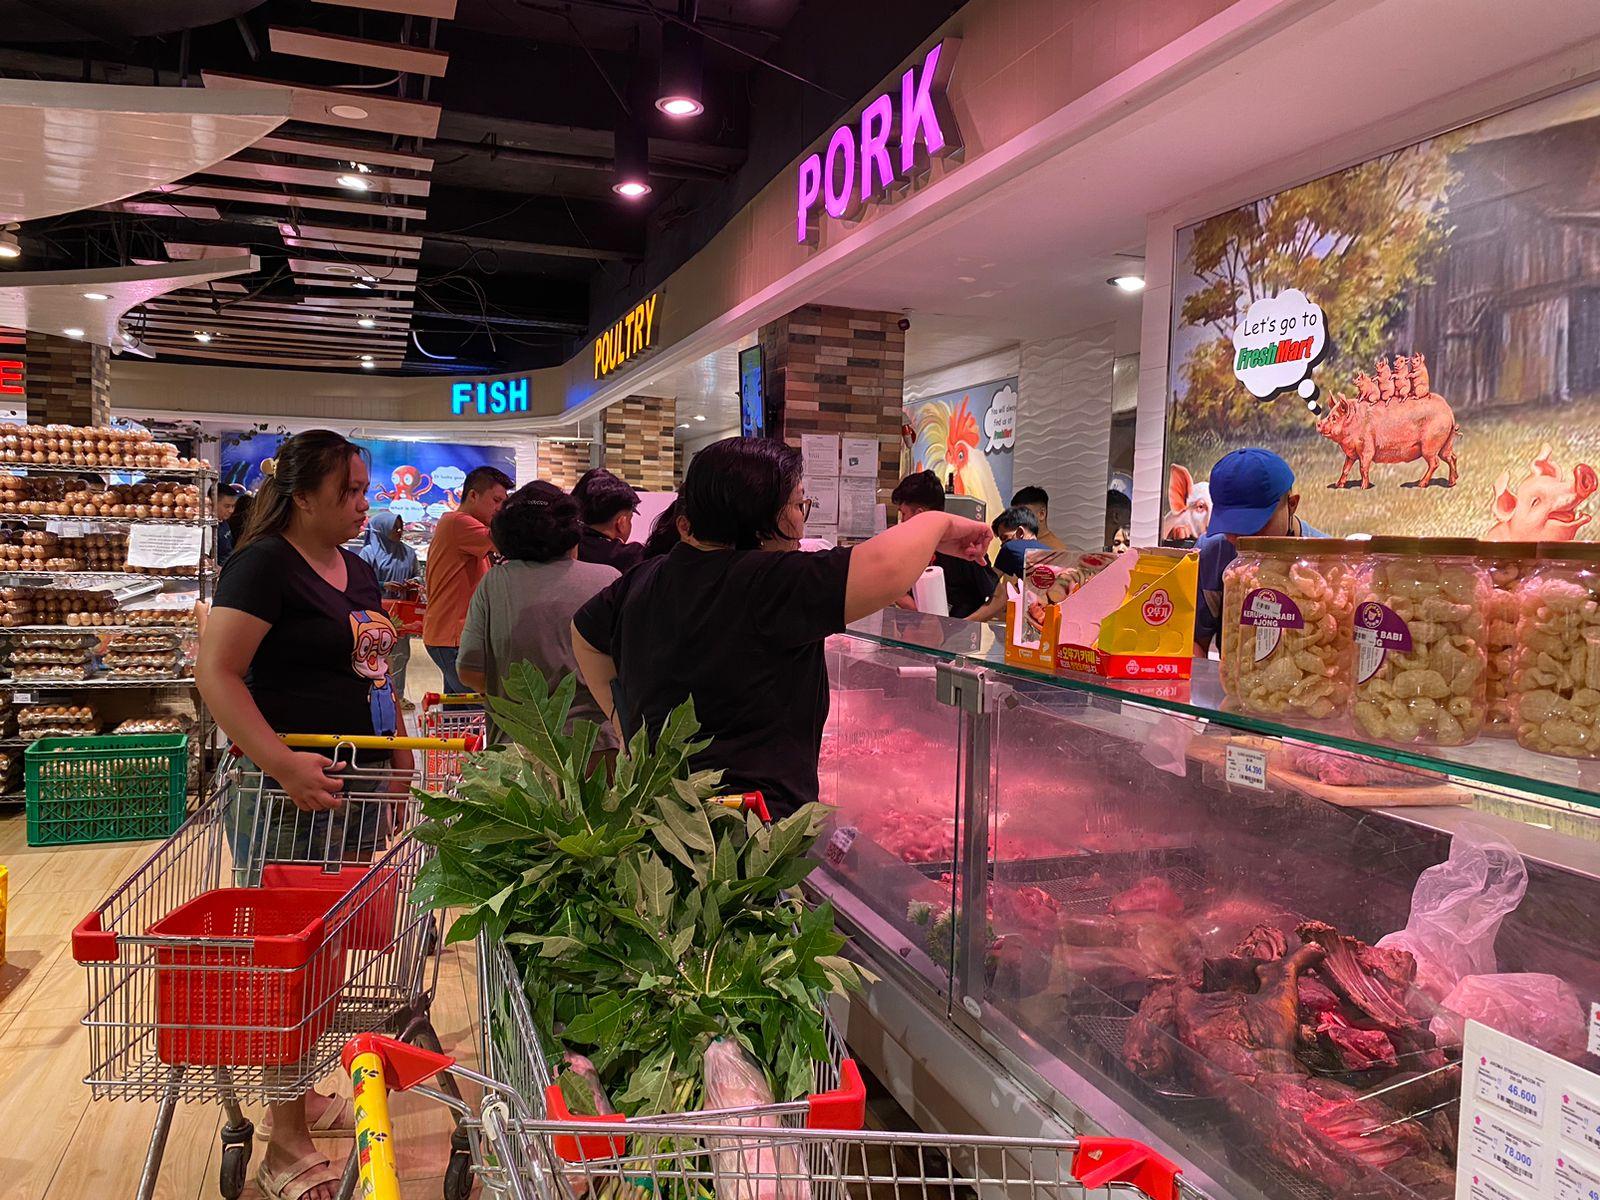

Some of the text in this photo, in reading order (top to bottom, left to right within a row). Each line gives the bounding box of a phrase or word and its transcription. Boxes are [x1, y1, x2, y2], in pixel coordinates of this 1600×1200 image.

[797, 42, 945, 243] PORK
[594, 293, 657, 380] POULTRY
[1243, 311, 1317, 337] Let's go to
[1236, 335, 1315, 371] FreshMart
[452, 378, 528, 415] FISH
[1253, 618, 1279, 628] AJONG
[1380, 631, 1404, 642] BABI
[1507, 1084, 1537, 1104] 46.600
[1504, 1143, 1532, 1167] 78.000
